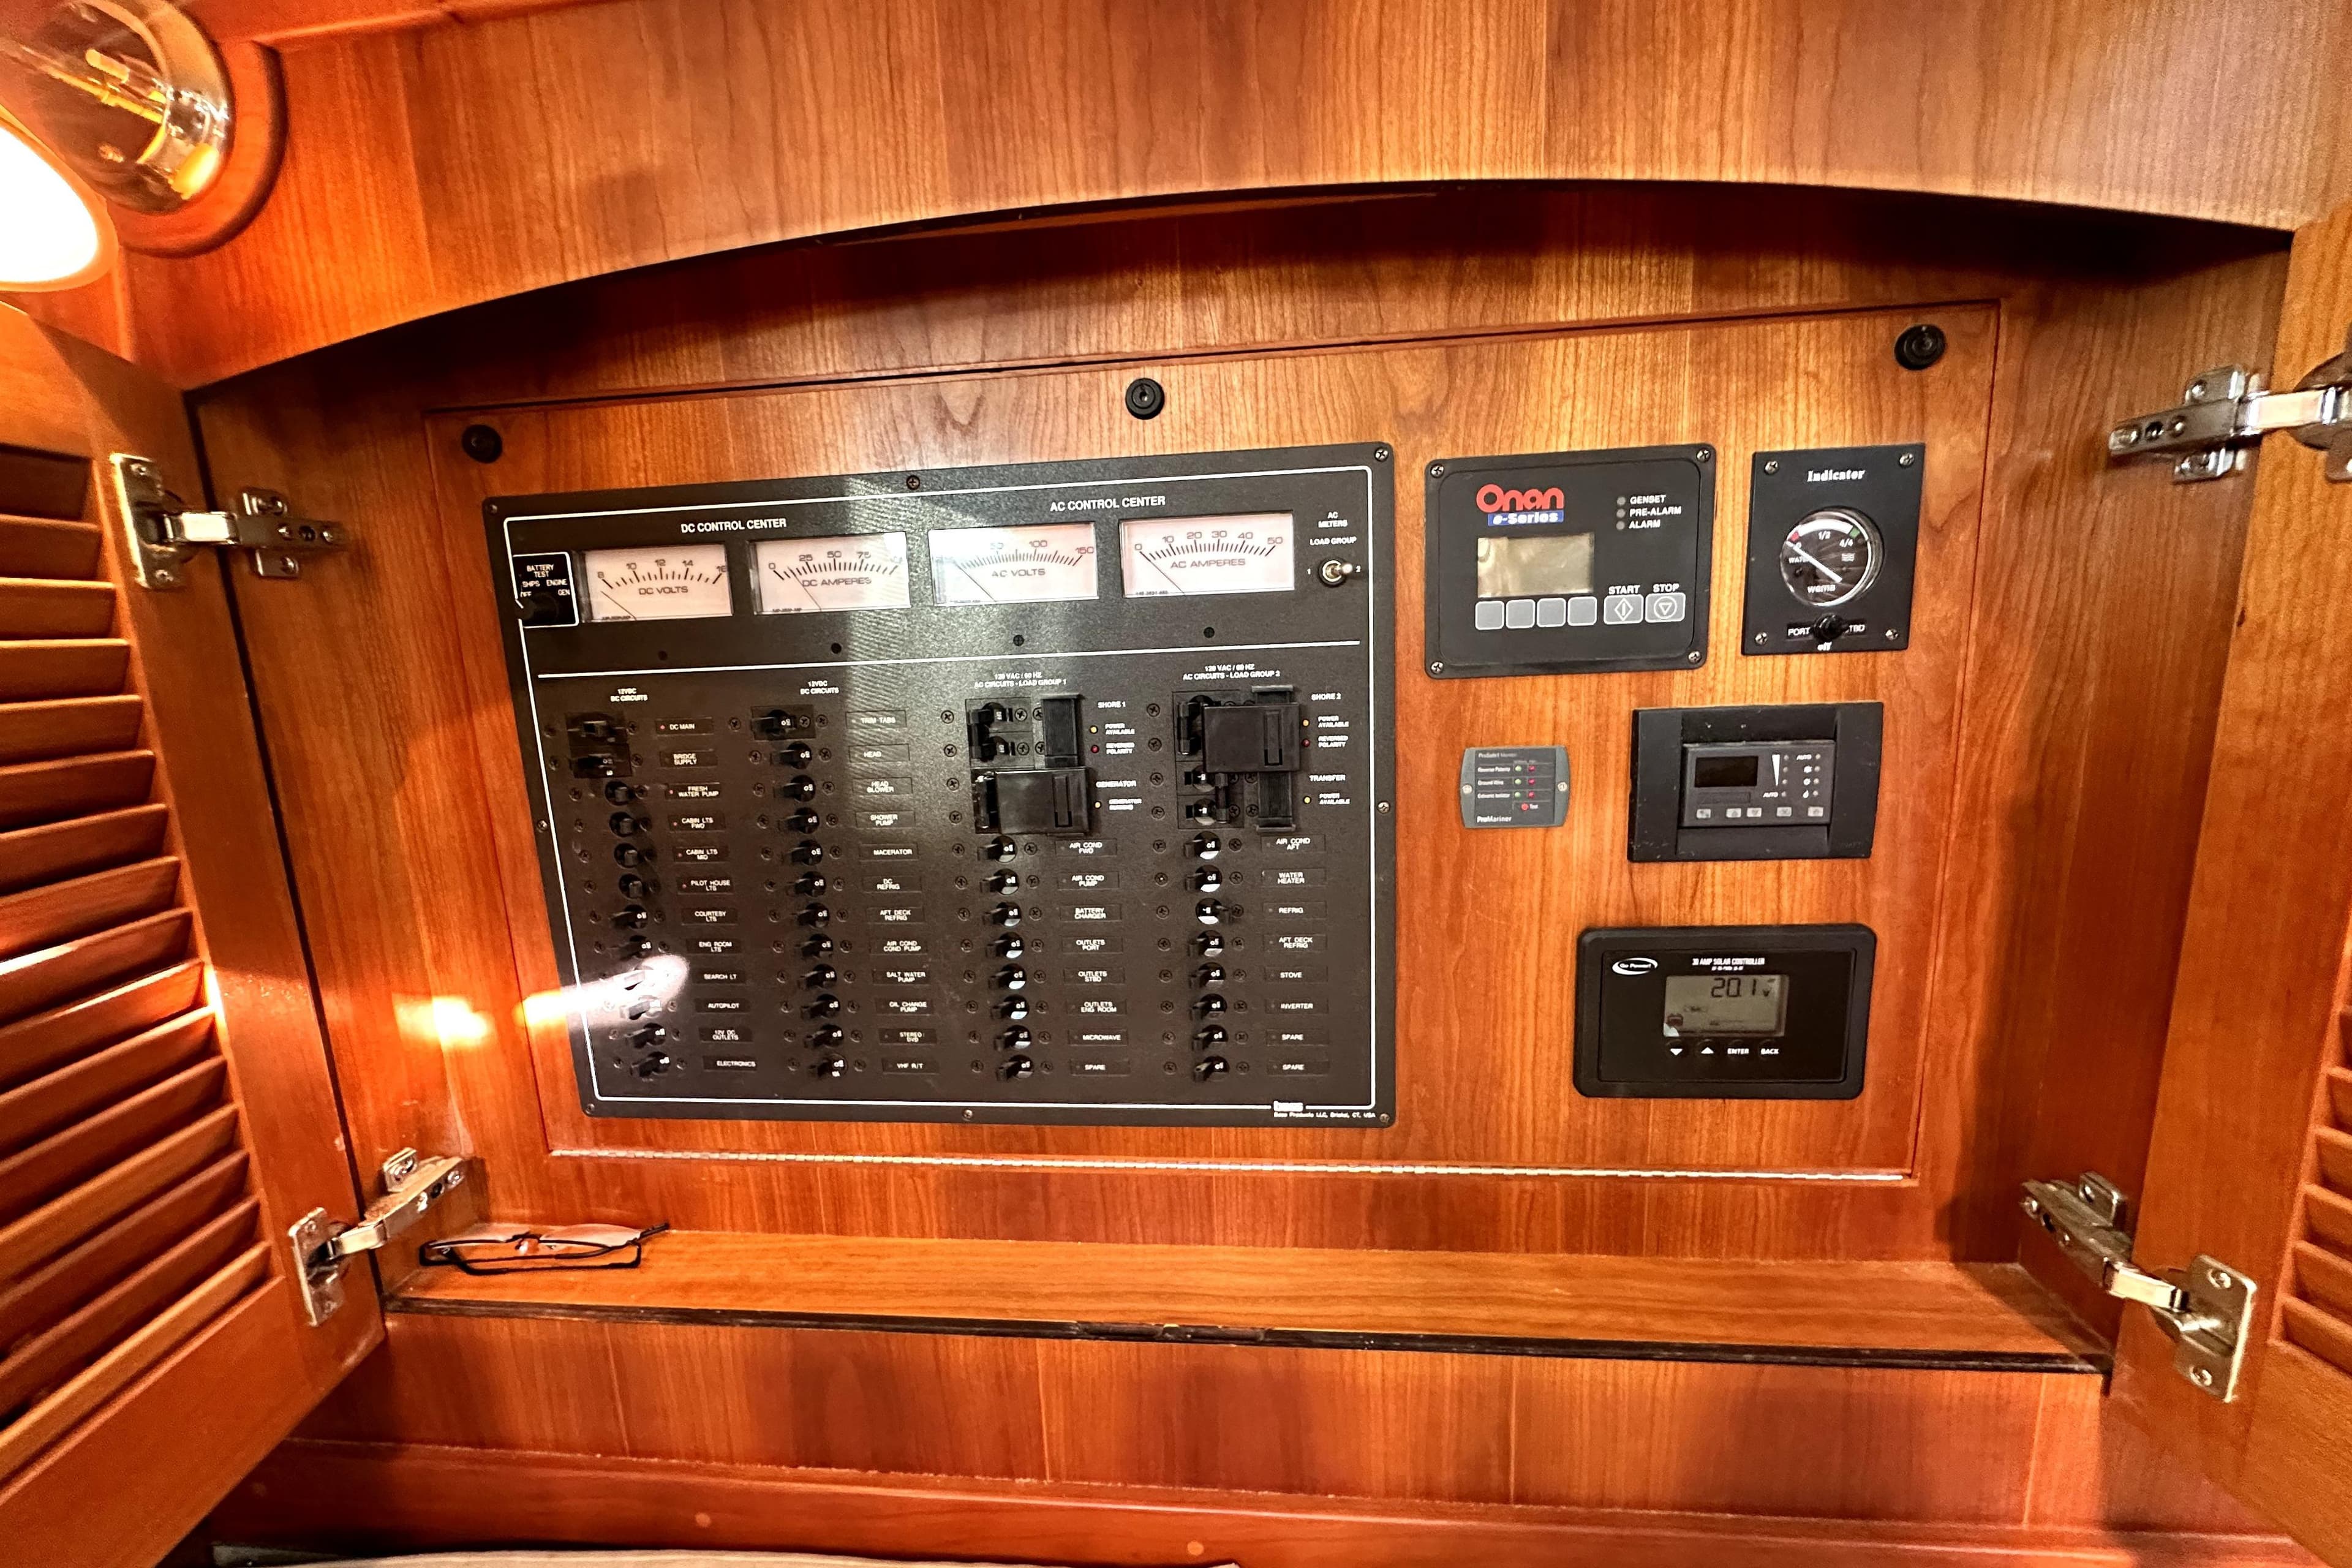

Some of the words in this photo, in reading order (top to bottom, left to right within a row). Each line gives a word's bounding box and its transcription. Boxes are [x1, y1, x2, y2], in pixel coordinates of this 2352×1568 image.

[1807, 469, 1865, 482] Indicator
[1476, 484, 1564, 513] Onan
[1630, 495, 1667, 504] GENSET
[1050, 501, 1065, 511] AC
[1067, 499, 1120, 511] CONTROL
[1121, 496, 1166, 507] CENTER
[1629, 506, 1682, 517] PRE-ALARM
[1492, 512, 1559, 525] e-Series
[681, 523, 696, 533] DC
[697, 521, 745, 532] CONTROL
[746, 518, 786, 530] CENTER
[1318, 519, 1348, 528] METERS
[1629, 519, 1661, 529] ALARM
[1818, 530, 1831, 540] 1/2
[1331, 536, 1357, 545] GROUP
[1839, 539, 1853, 548] 4/4
[1190, 558, 1246, 567] AMPERES
[527, 564, 554, 572] BATTERY
[1011, 568, 1046, 576] VOLTS
[1608, 585, 1640, 594] START
[1653, 583, 1679, 593] STOP
[1788, 627, 1811, 636] PORT
[1845, 625, 1865, 633] TBD
